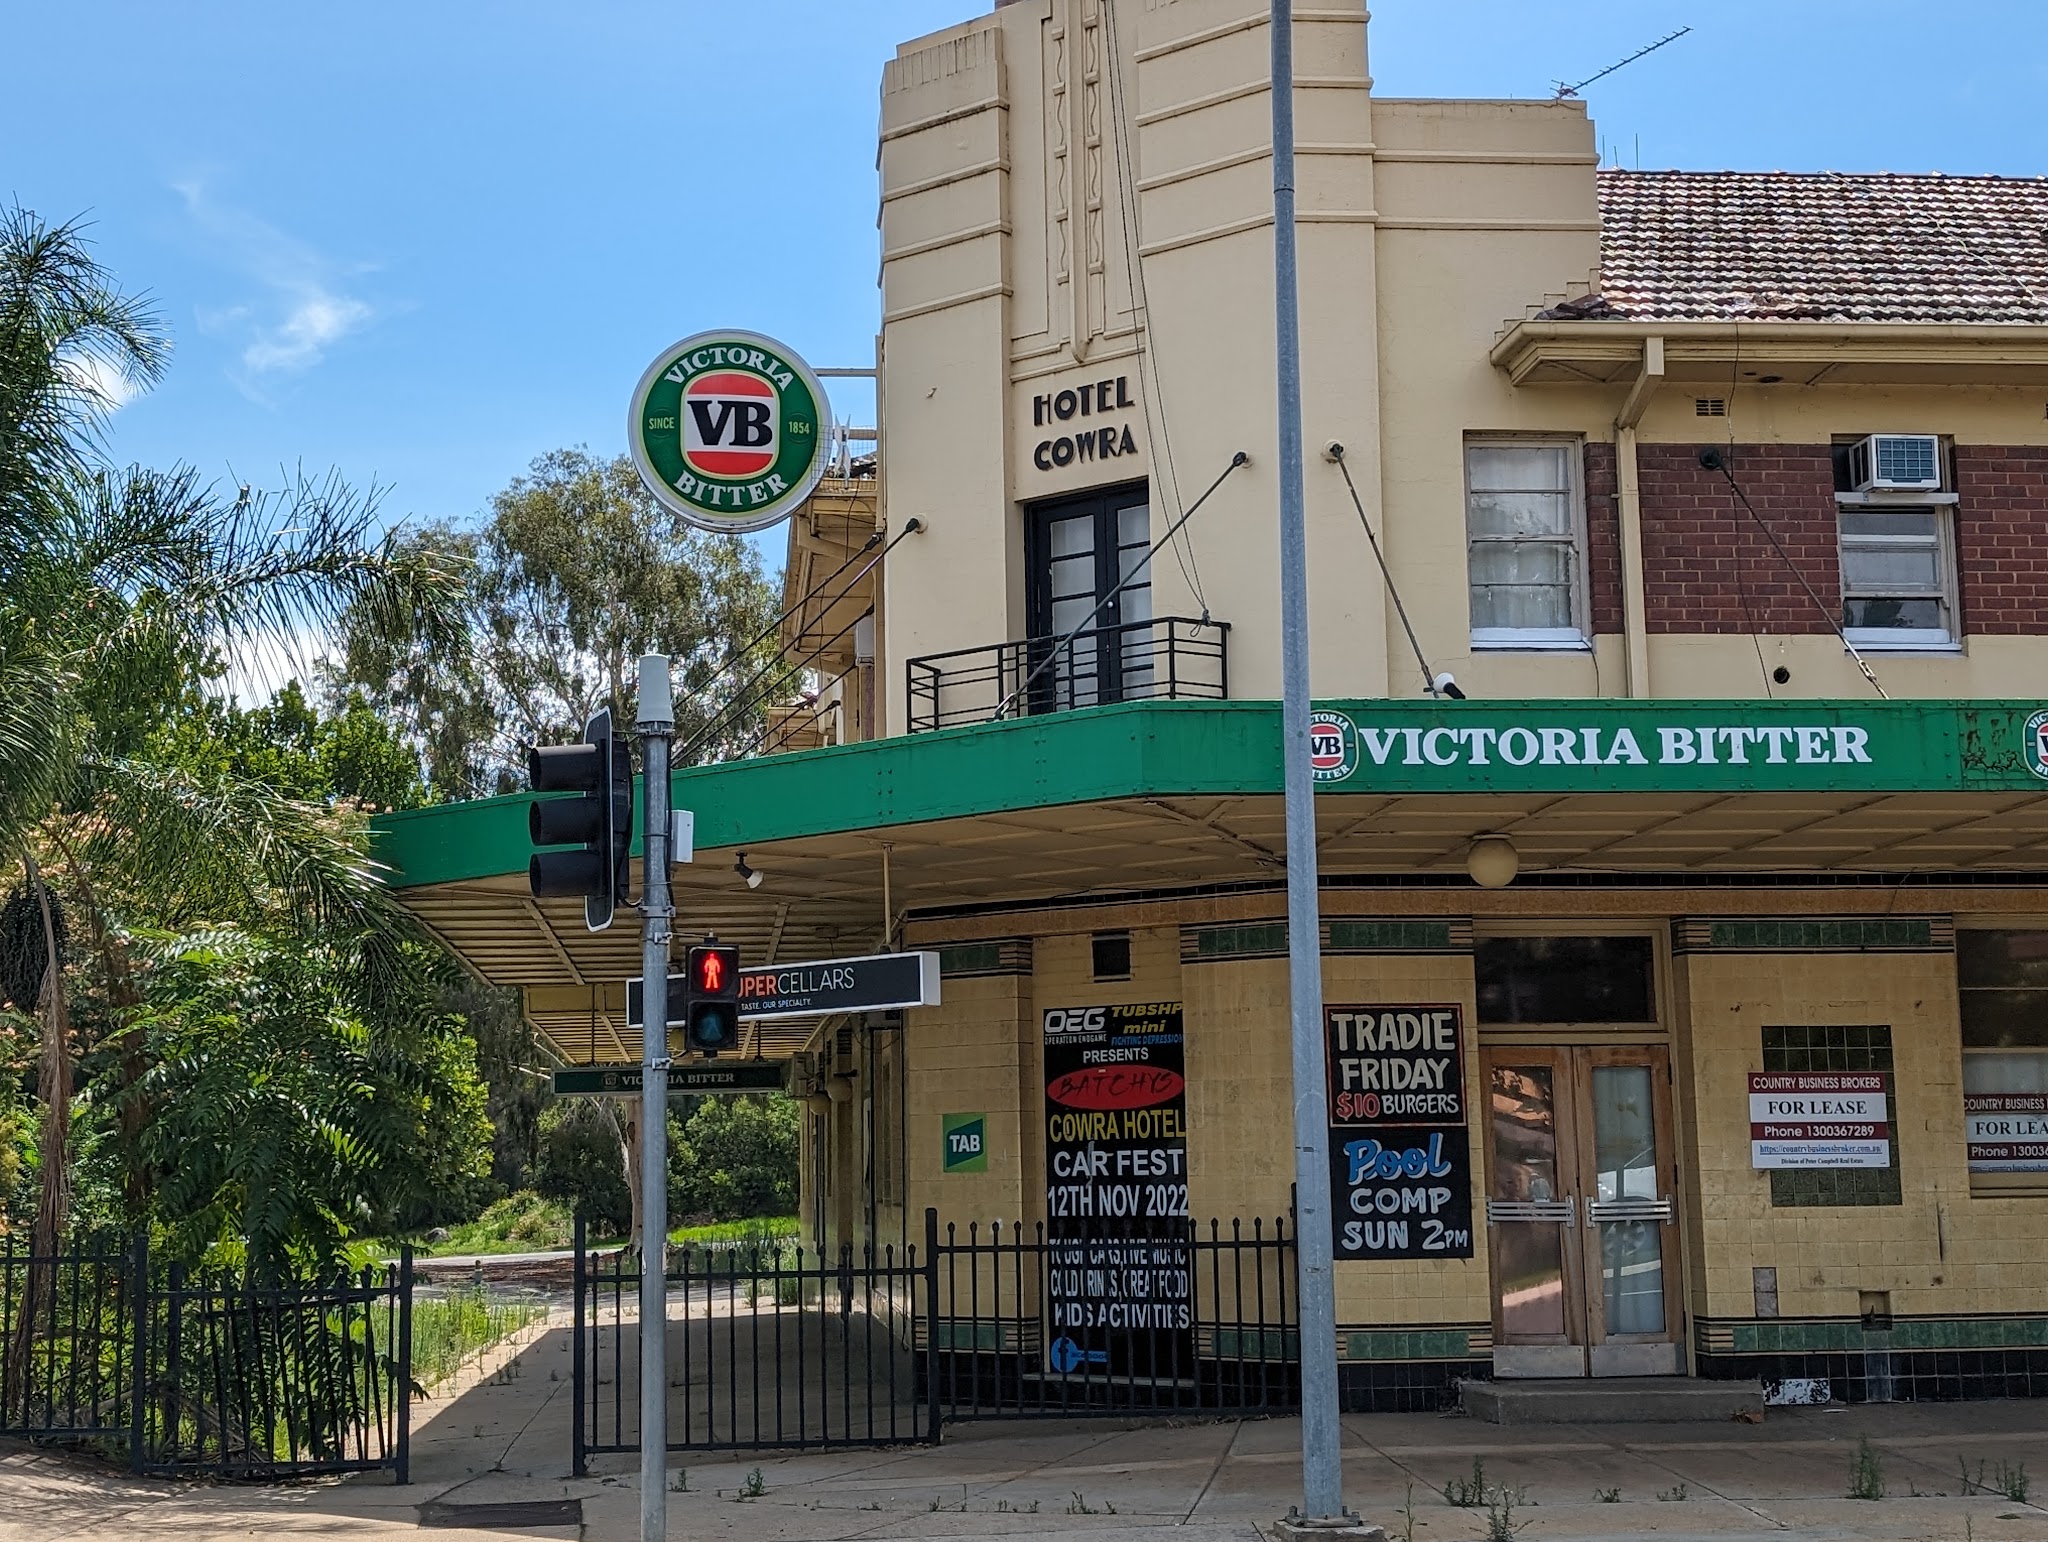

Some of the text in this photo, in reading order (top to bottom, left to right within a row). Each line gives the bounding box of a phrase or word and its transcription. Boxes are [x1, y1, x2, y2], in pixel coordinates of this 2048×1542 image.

[664, 347, 795, 391] VICTORIA
[1033, 376, 1135, 426] HOTEL
[648, 400, 810, 447] SINCE VB 1854
[1033, 423, 1138, 471] COWRA
[672, 470, 789, 506] BITTER
[1310, 713, 1349, 731] TORIA
[1311, 736, 1341, 755] VB
[1359, 727, 1873, 765] VICTORIA BITTER
[1312, 764, 1350, 779] ITTER
[762, 1000, 777, 1009] OUR
[1044, 1008, 1106, 1033] OEG
[1123, 1020, 1166, 1034] mini
[1331, 1012, 1456, 1051] TRADIE
[1111, 1035, 1141, 1046] FIGHTING
[1083, 1047, 1149, 1063] PRESENTS
[688, 1072, 735, 1084] BITTER
[1056, 1072, 1173, 1100] BATCHYS
[1339, 1057, 1450, 1090] FRIDAY
[1753, 1077, 1881, 1090] COUNTRY BUSINESS BROKERS
[1336, 1091, 1459, 1121] $10 BURGERS
[1768, 1101, 1867, 1115] FOR LEASE
[1964, 1098, 2004, 1110] COUNTRY
[2005, 1098, 2044, 1109] BUSINESS
[1050, 1109, 1186, 1143] COWRA HOTEL
[1764, 1125, 1875, 1137] Phone 1300367289
[1975, 1121, 2011, 1135] FOR
[949, 1134, 981, 1153] TAB
[1971, 1146, 2009, 1157] Phone
[1054, 1149, 1184, 1177] CAR FEST
[1344, 1133, 1451, 1186] Pool
[1817, 1157, 1839, 1166] Campbell
[1048, 1184, 1188, 1217] 12TH NOV 2022
[1350, 1187, 1451, 1215] COMP
[1341, 1220, 1409, 1251] SUN
